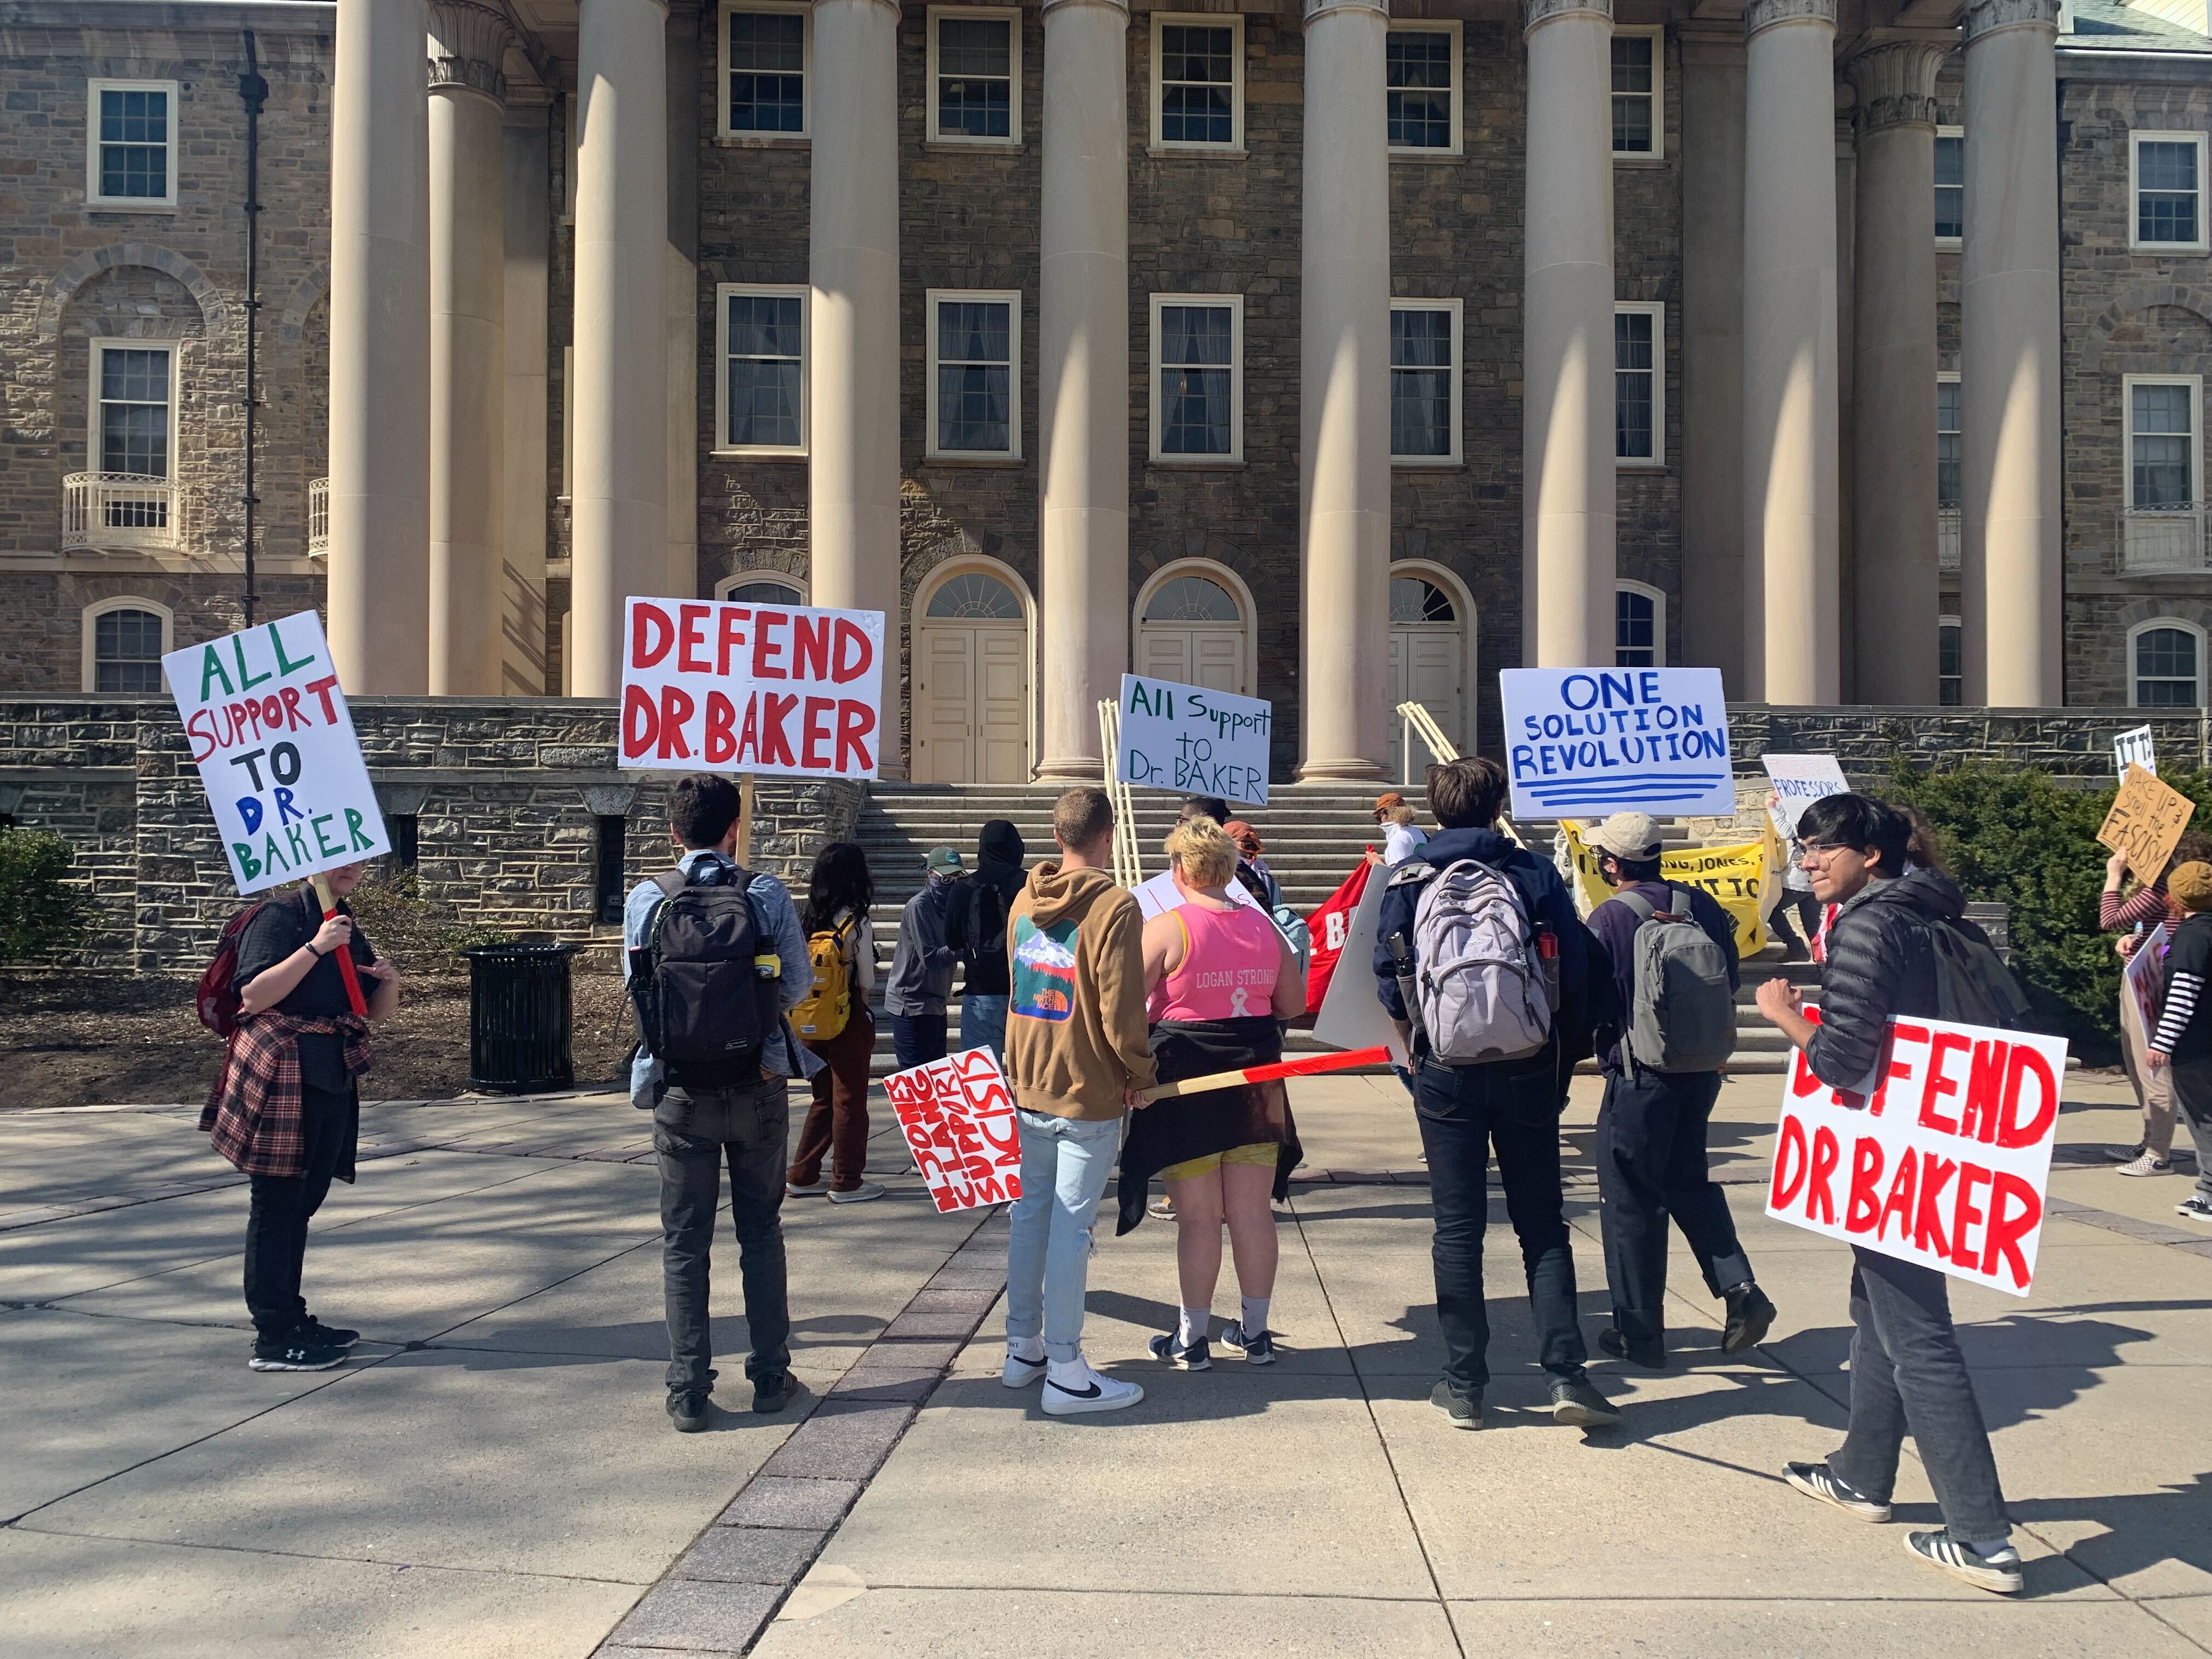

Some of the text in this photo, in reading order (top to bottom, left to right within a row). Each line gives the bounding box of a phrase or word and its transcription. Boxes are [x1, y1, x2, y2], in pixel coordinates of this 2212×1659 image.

[200, 622, 315, 702] ALL
[632, 602, 872, 684] DEFEND
[1131, 681, 1271, 741] All Support
[1561, 672, 1661, 711] ONE
[187, 674, 338, 763] SUPPORT
[623, 684, 876, 772] DR. BAKER
[1525, 704, 1703, 741] SOLUTION
[229, 741, 301, 793] TO
[1130, 749, 1265, 804] Dr. BAKER
[1513, 728, 1726, 779] REVOLUTION
[236, 787, 312, 836] DR.
[1773, 778, 1843, 798] PROFESSORS
[2127, 771, 2158, 801] WAKE
[2157, 789, 2177, 819] UP
[232, 808, 375, 882] BAKER
[2103, 807, 2169, 879] FASCISM
[2148, 811, 2165, 838] the
[1697, 857, 1755, 872] JONES,
[1042, 988, 1055, 997] THE
[1196, 968, 1273, 989] LOGAN STRONG
[884, 1075, 944, 1180] JONES
[926, 1065, 1006, 1203] SUPPORT
[1844, 1134, 2041, 1289] BAKER
